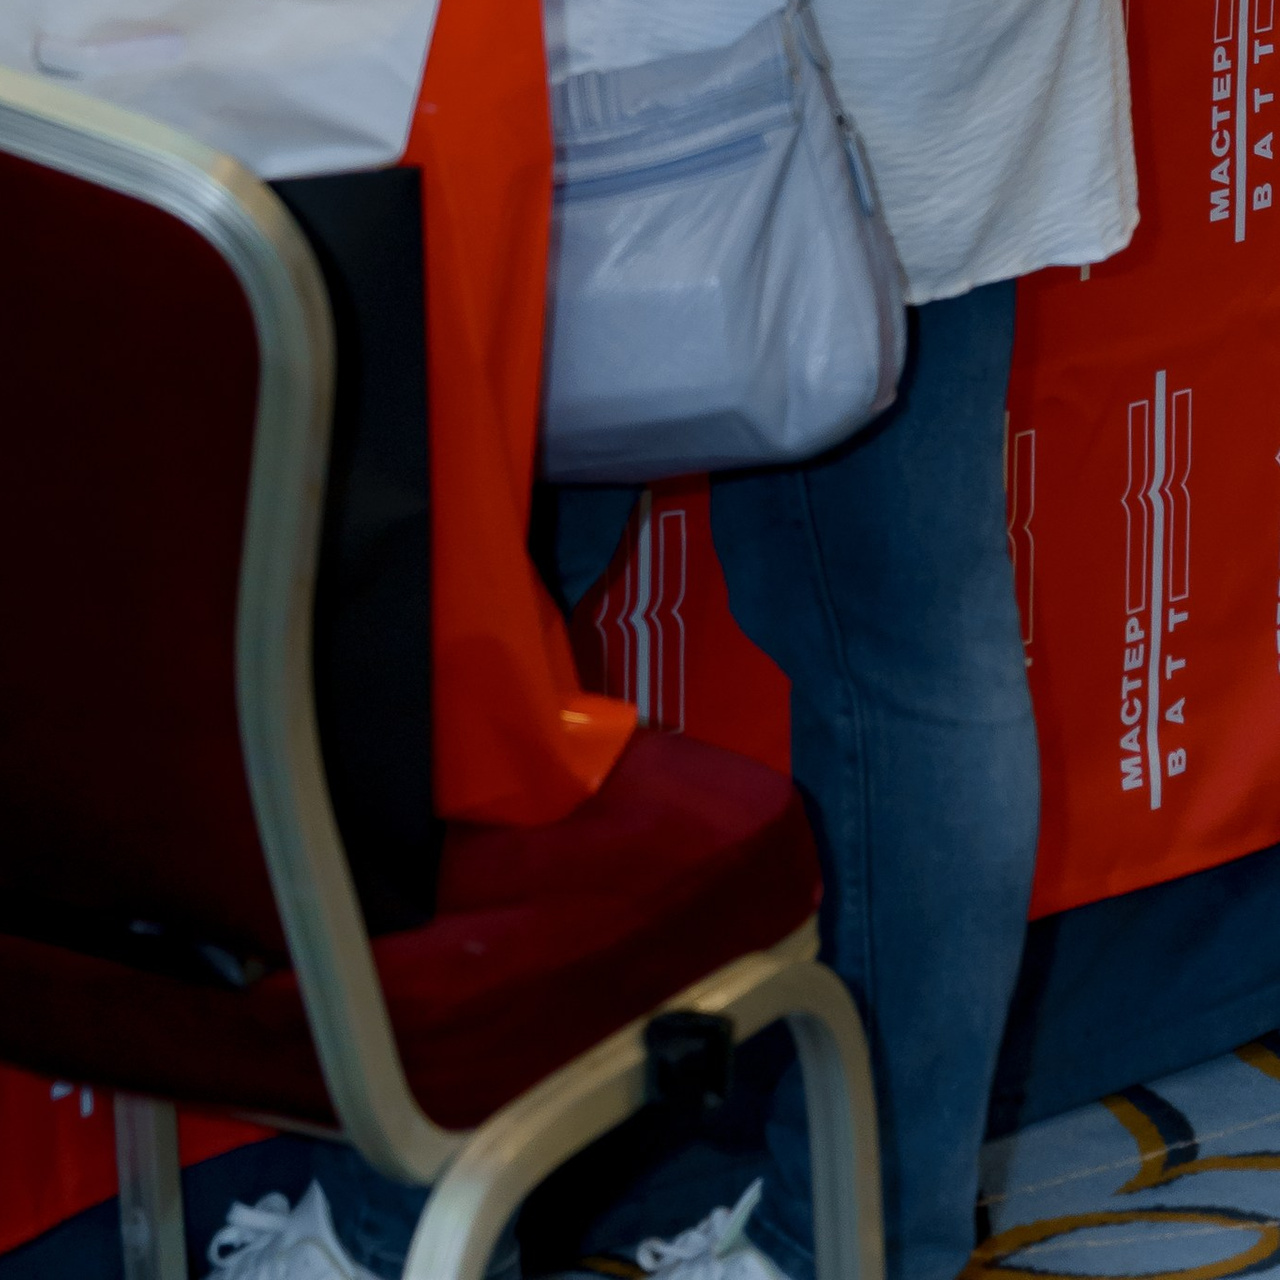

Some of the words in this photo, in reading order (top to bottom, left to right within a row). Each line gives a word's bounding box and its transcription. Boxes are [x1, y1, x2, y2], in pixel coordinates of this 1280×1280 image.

[1209, 45, 1232, 223] МАСТЕР
[1252, 39, 1274, 211] ВАТТ
[1120, 616, 1145, 791] МАСТЕР
[1164, 607, 1189, 778] ВАТТ
